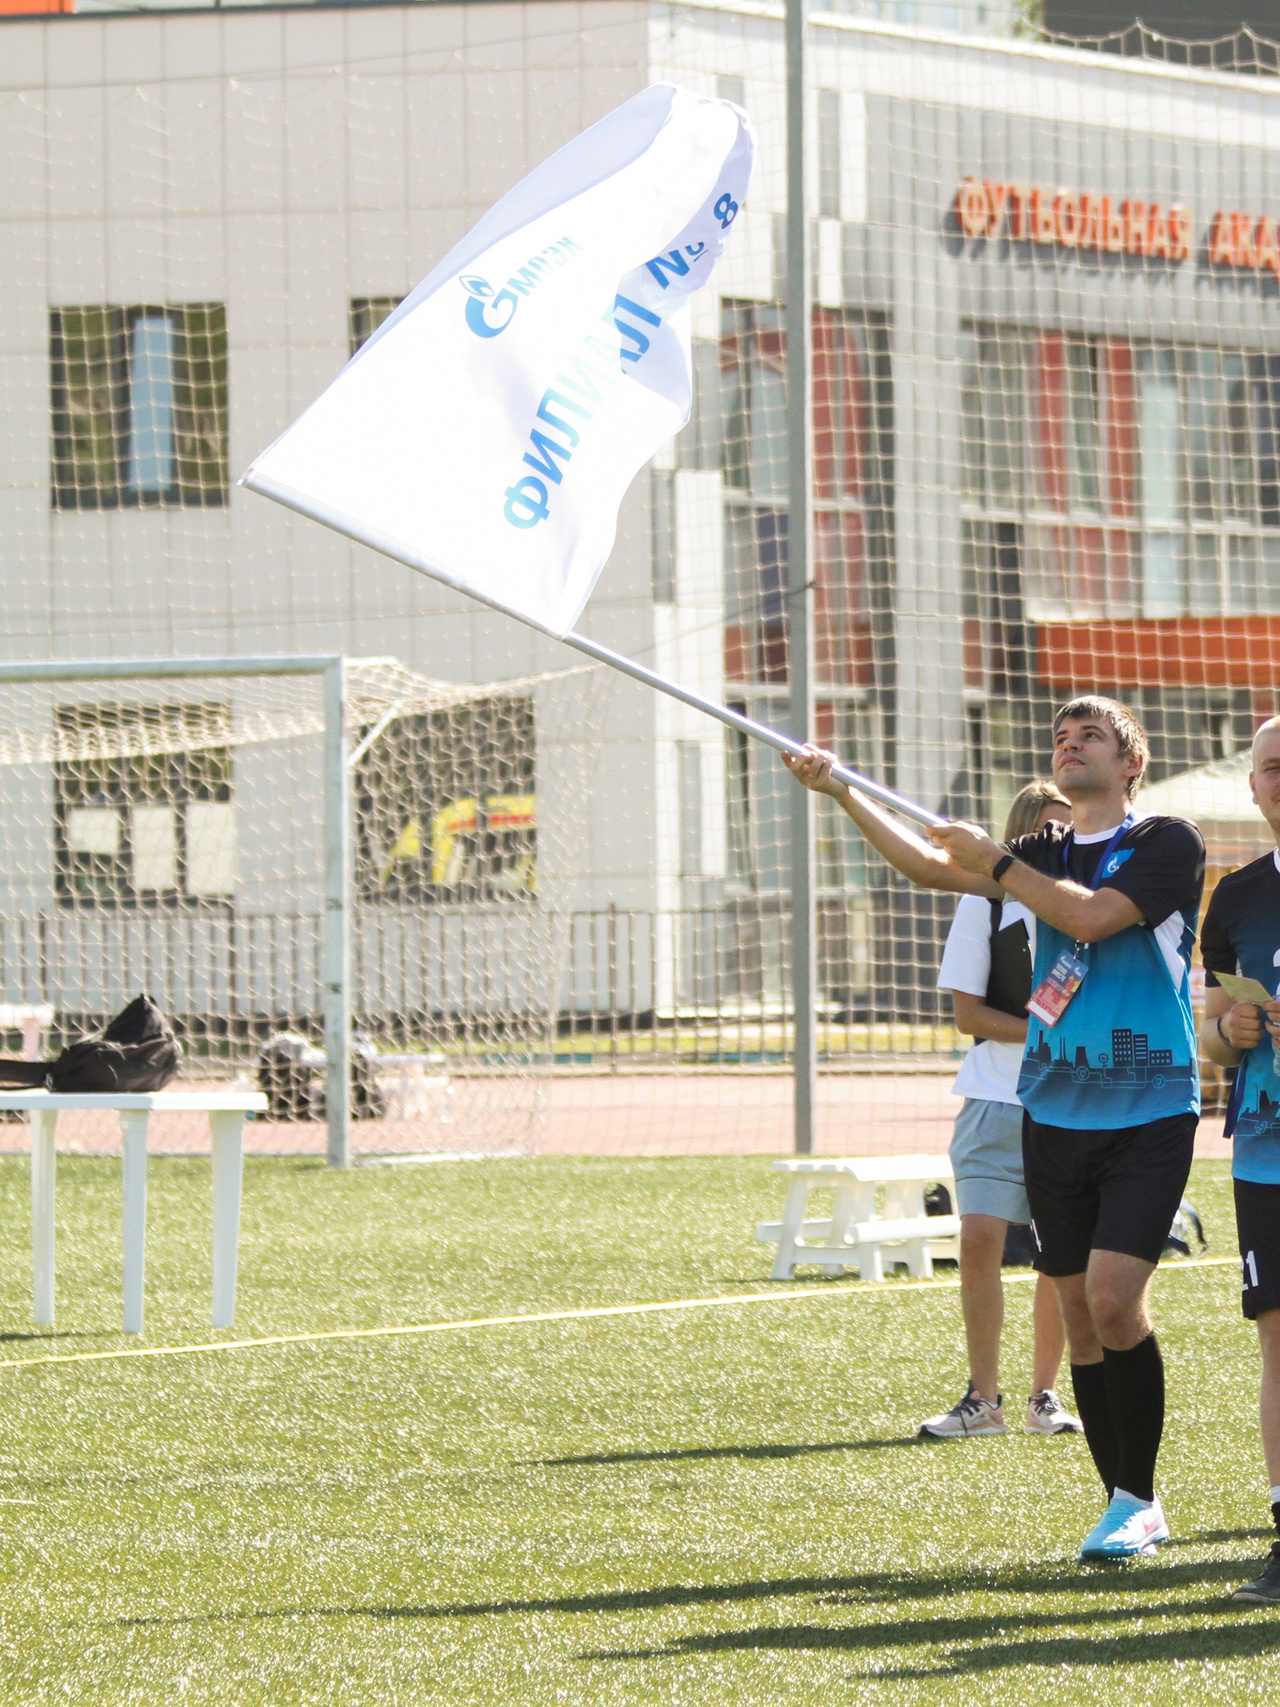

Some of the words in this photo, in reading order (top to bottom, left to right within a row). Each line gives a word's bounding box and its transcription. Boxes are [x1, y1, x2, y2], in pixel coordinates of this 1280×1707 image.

[956, 177, 1192, 260] ФУТБОЛЬНАЯ
[503, 293, 661, 529] ФИЛИАЛ
[713, 192, 739, 230] 8
[1242, 1250, 1258, 1291] 1
